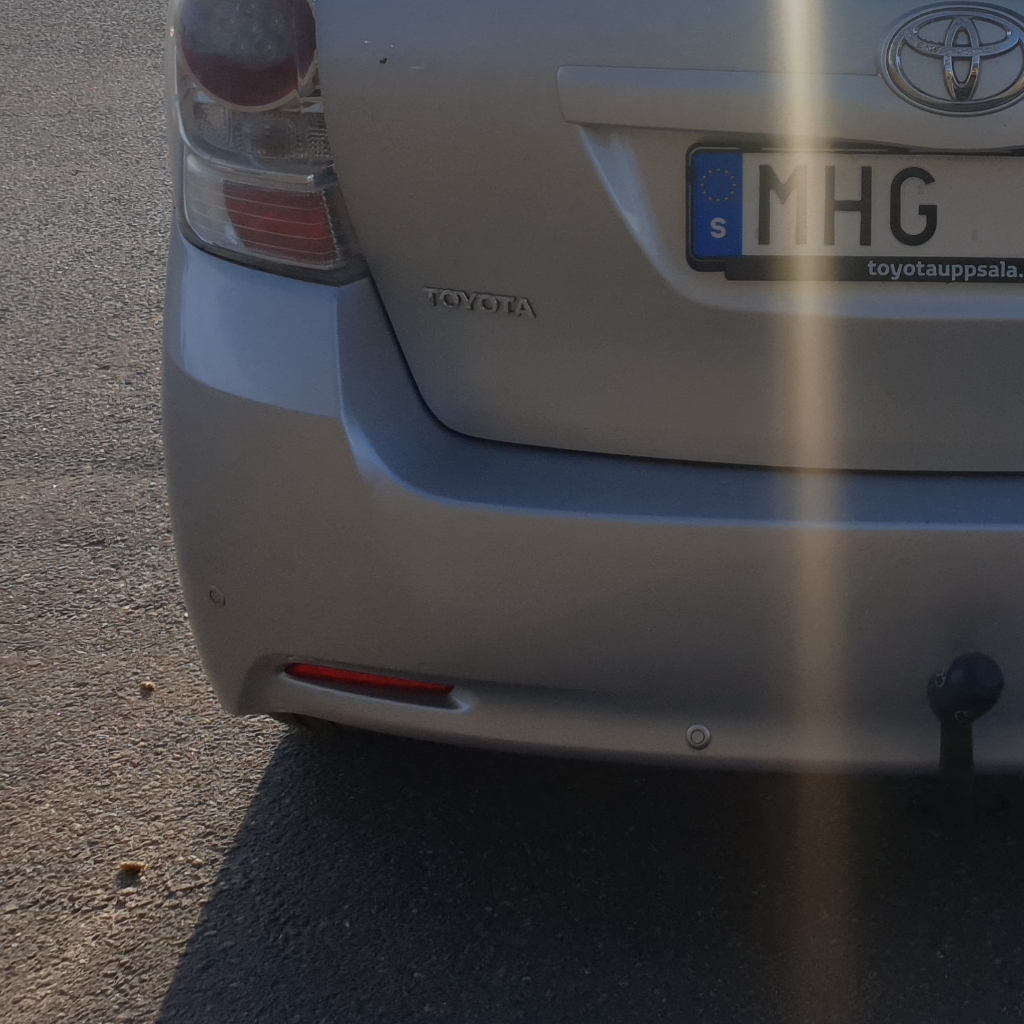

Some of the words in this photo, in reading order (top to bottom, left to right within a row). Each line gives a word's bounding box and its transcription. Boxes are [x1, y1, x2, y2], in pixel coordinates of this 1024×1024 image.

[758, 164, 938, 246] MHG
[710, 217, 727, 239] S
[423, 286, 537, 318] TOYOTA
